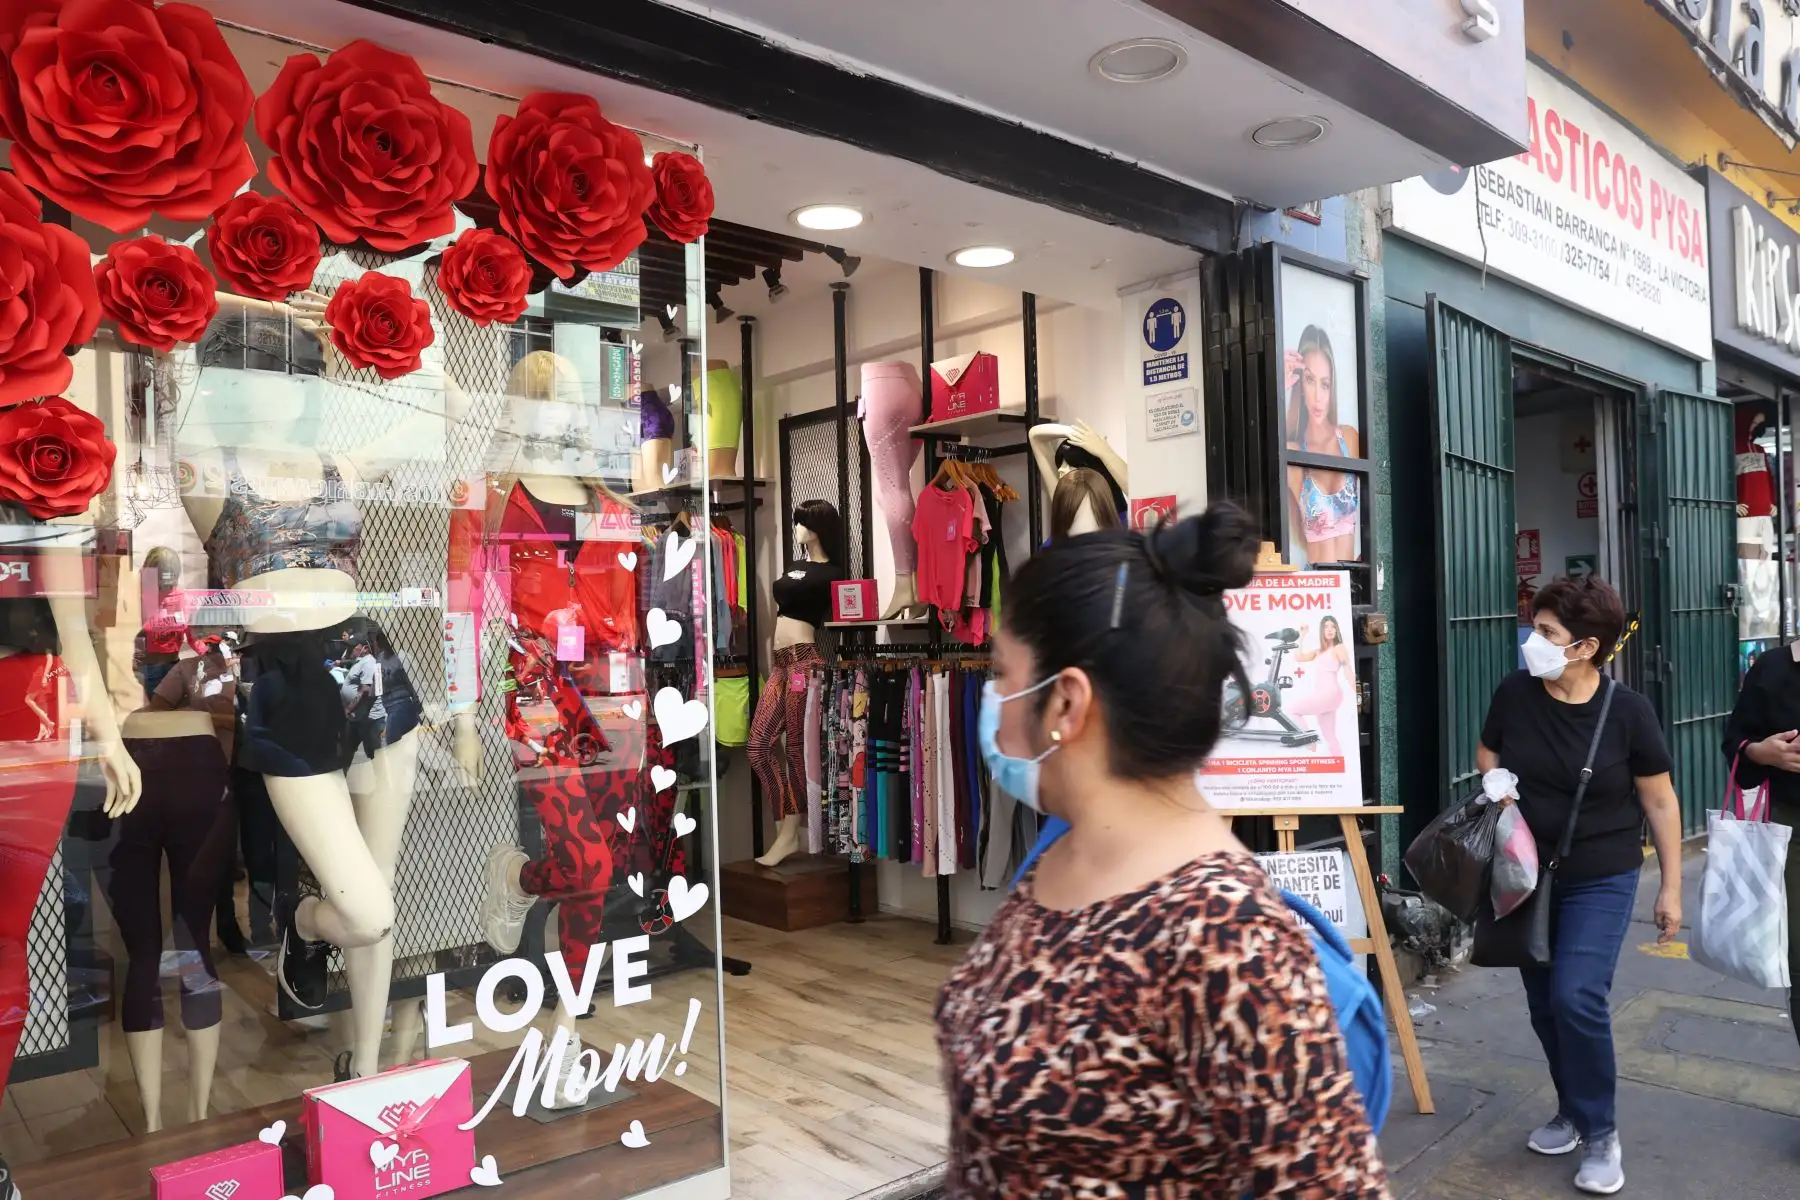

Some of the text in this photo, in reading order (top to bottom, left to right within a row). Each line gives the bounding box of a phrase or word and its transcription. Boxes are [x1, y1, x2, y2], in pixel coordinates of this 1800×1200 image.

[1514, 97, 1705, 268] ASTICOS PYSA
[1478, 200, 1505, 233] TELF:
[1478, 164, 1552, 224] SEBASTIAN
[1555, 206, 1618, 253] BARRANCA
[1658, 261, 1670, 286] LA
[1670, 269, 1708, 304] VICTORIA
[1146, 357, 1177, 369] MANTENER
[1146, 362, 1185, 376] DISTANCIA DE
[1158, 371, 1182, 381] METROS
[1265, 578, 1280, 588] DE
[1281, 578, 1296, 587] LA
[1297, 577, 1336, 587] MADRE
[1222, 592, 1332, 611] OVE MOM!
[1266, 855, 1338, 875] NECESITA
[1271, 874, 1341, 892] DANTE DE
[426, 934, 652, 1049] LOVE
[457, 997, 702, 1131] Mom!
[375, 1163, 431, 1191] LINE
[375, 1179, 431, 1200] FITNESS
